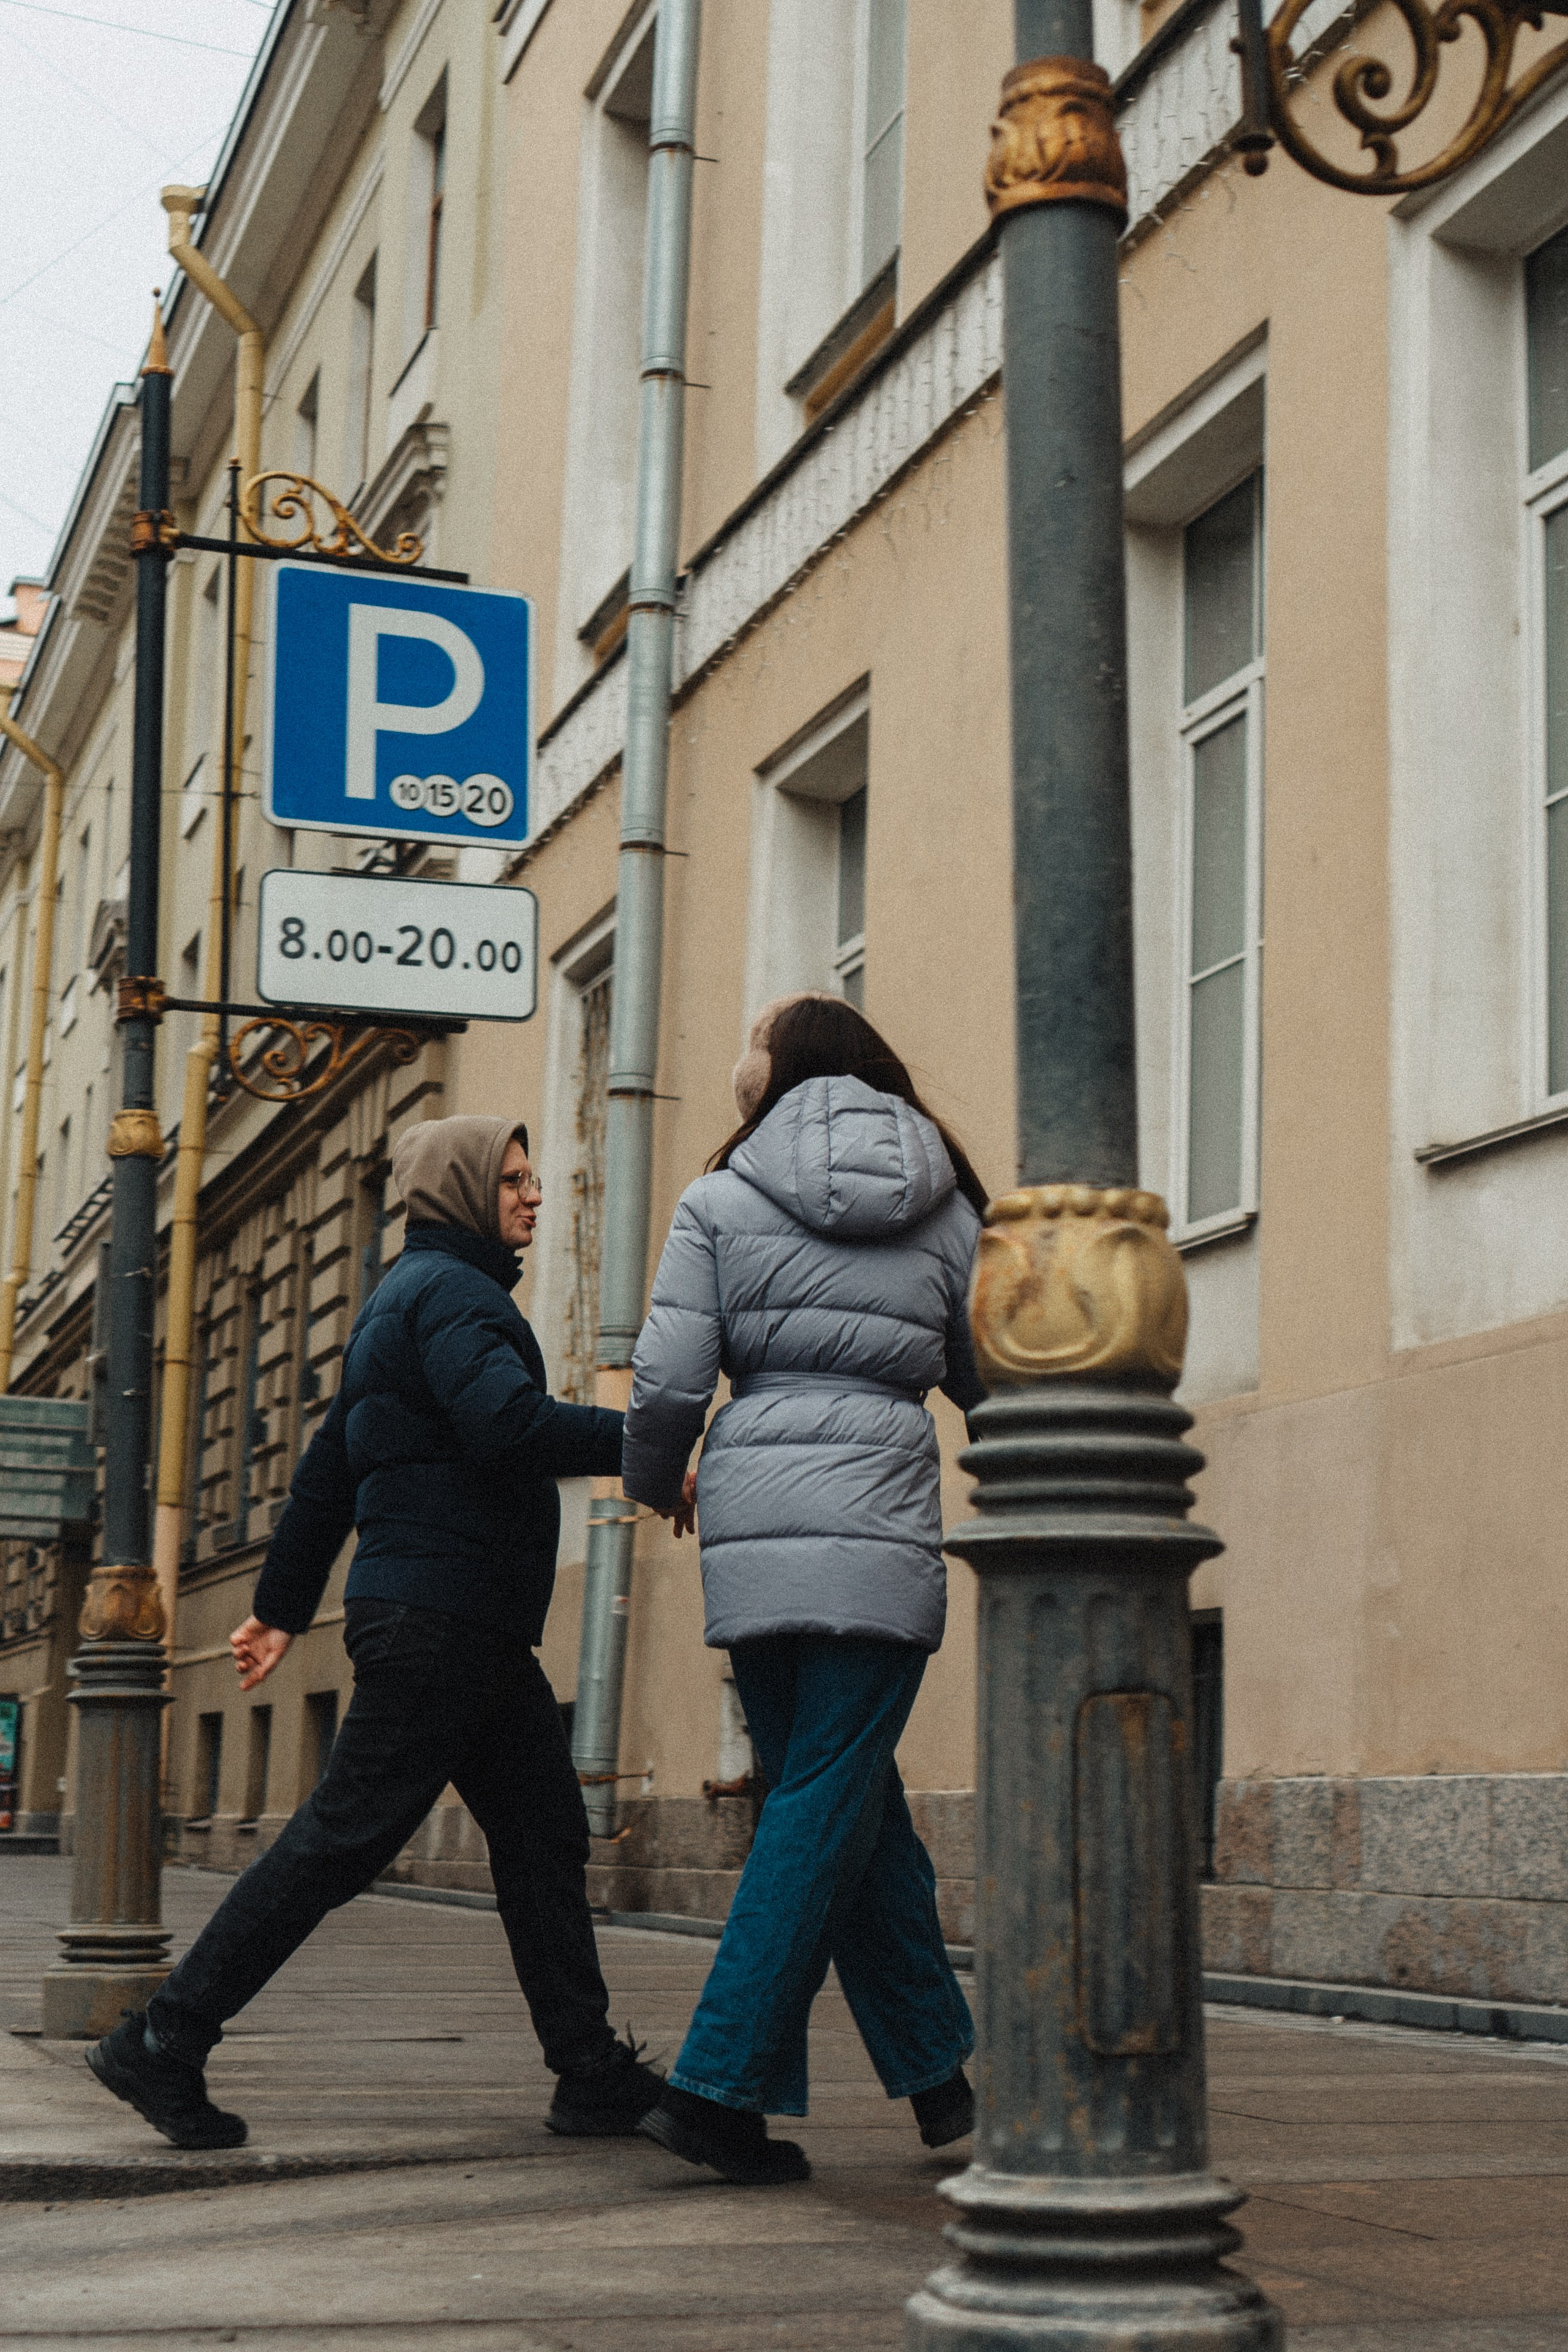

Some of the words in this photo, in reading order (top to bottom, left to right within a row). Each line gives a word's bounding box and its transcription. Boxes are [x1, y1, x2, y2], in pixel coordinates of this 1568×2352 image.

[345, 603, 485, 800] P
[399, 782, 421, 801] 10
[429, 783, 454, 807] 15
[467, 784, 506, 815] 20
[279, 916, 522, 974] 8.00-20.00
